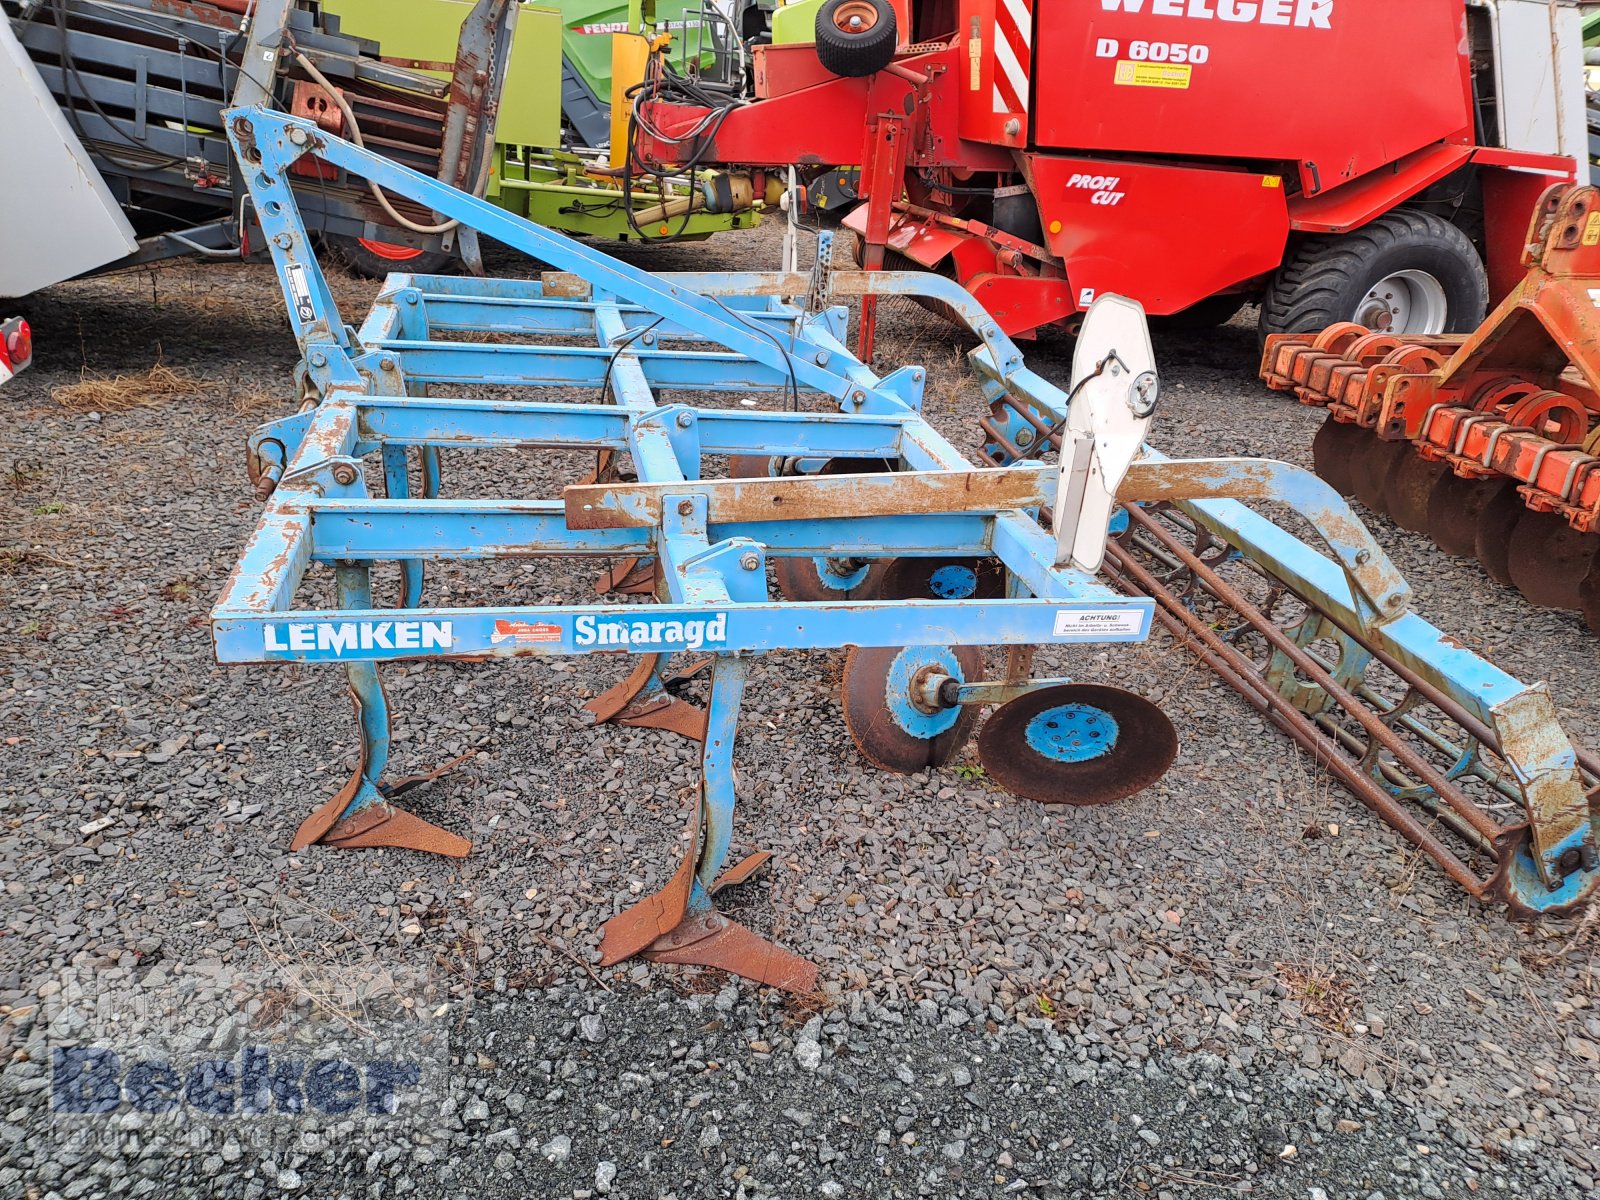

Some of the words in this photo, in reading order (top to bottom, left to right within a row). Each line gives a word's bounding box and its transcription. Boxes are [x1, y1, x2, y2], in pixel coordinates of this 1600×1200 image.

[1095, 38, 1119, 58] D
[1128, 40, 1209, 64] 6050
[1065, 173, 1120, 191] PROFI
[1090, 190, 1125, 206] CUT
[263, 621, 453, 657] LEMKEN
[575, 613, 727, 649] Smaragd
